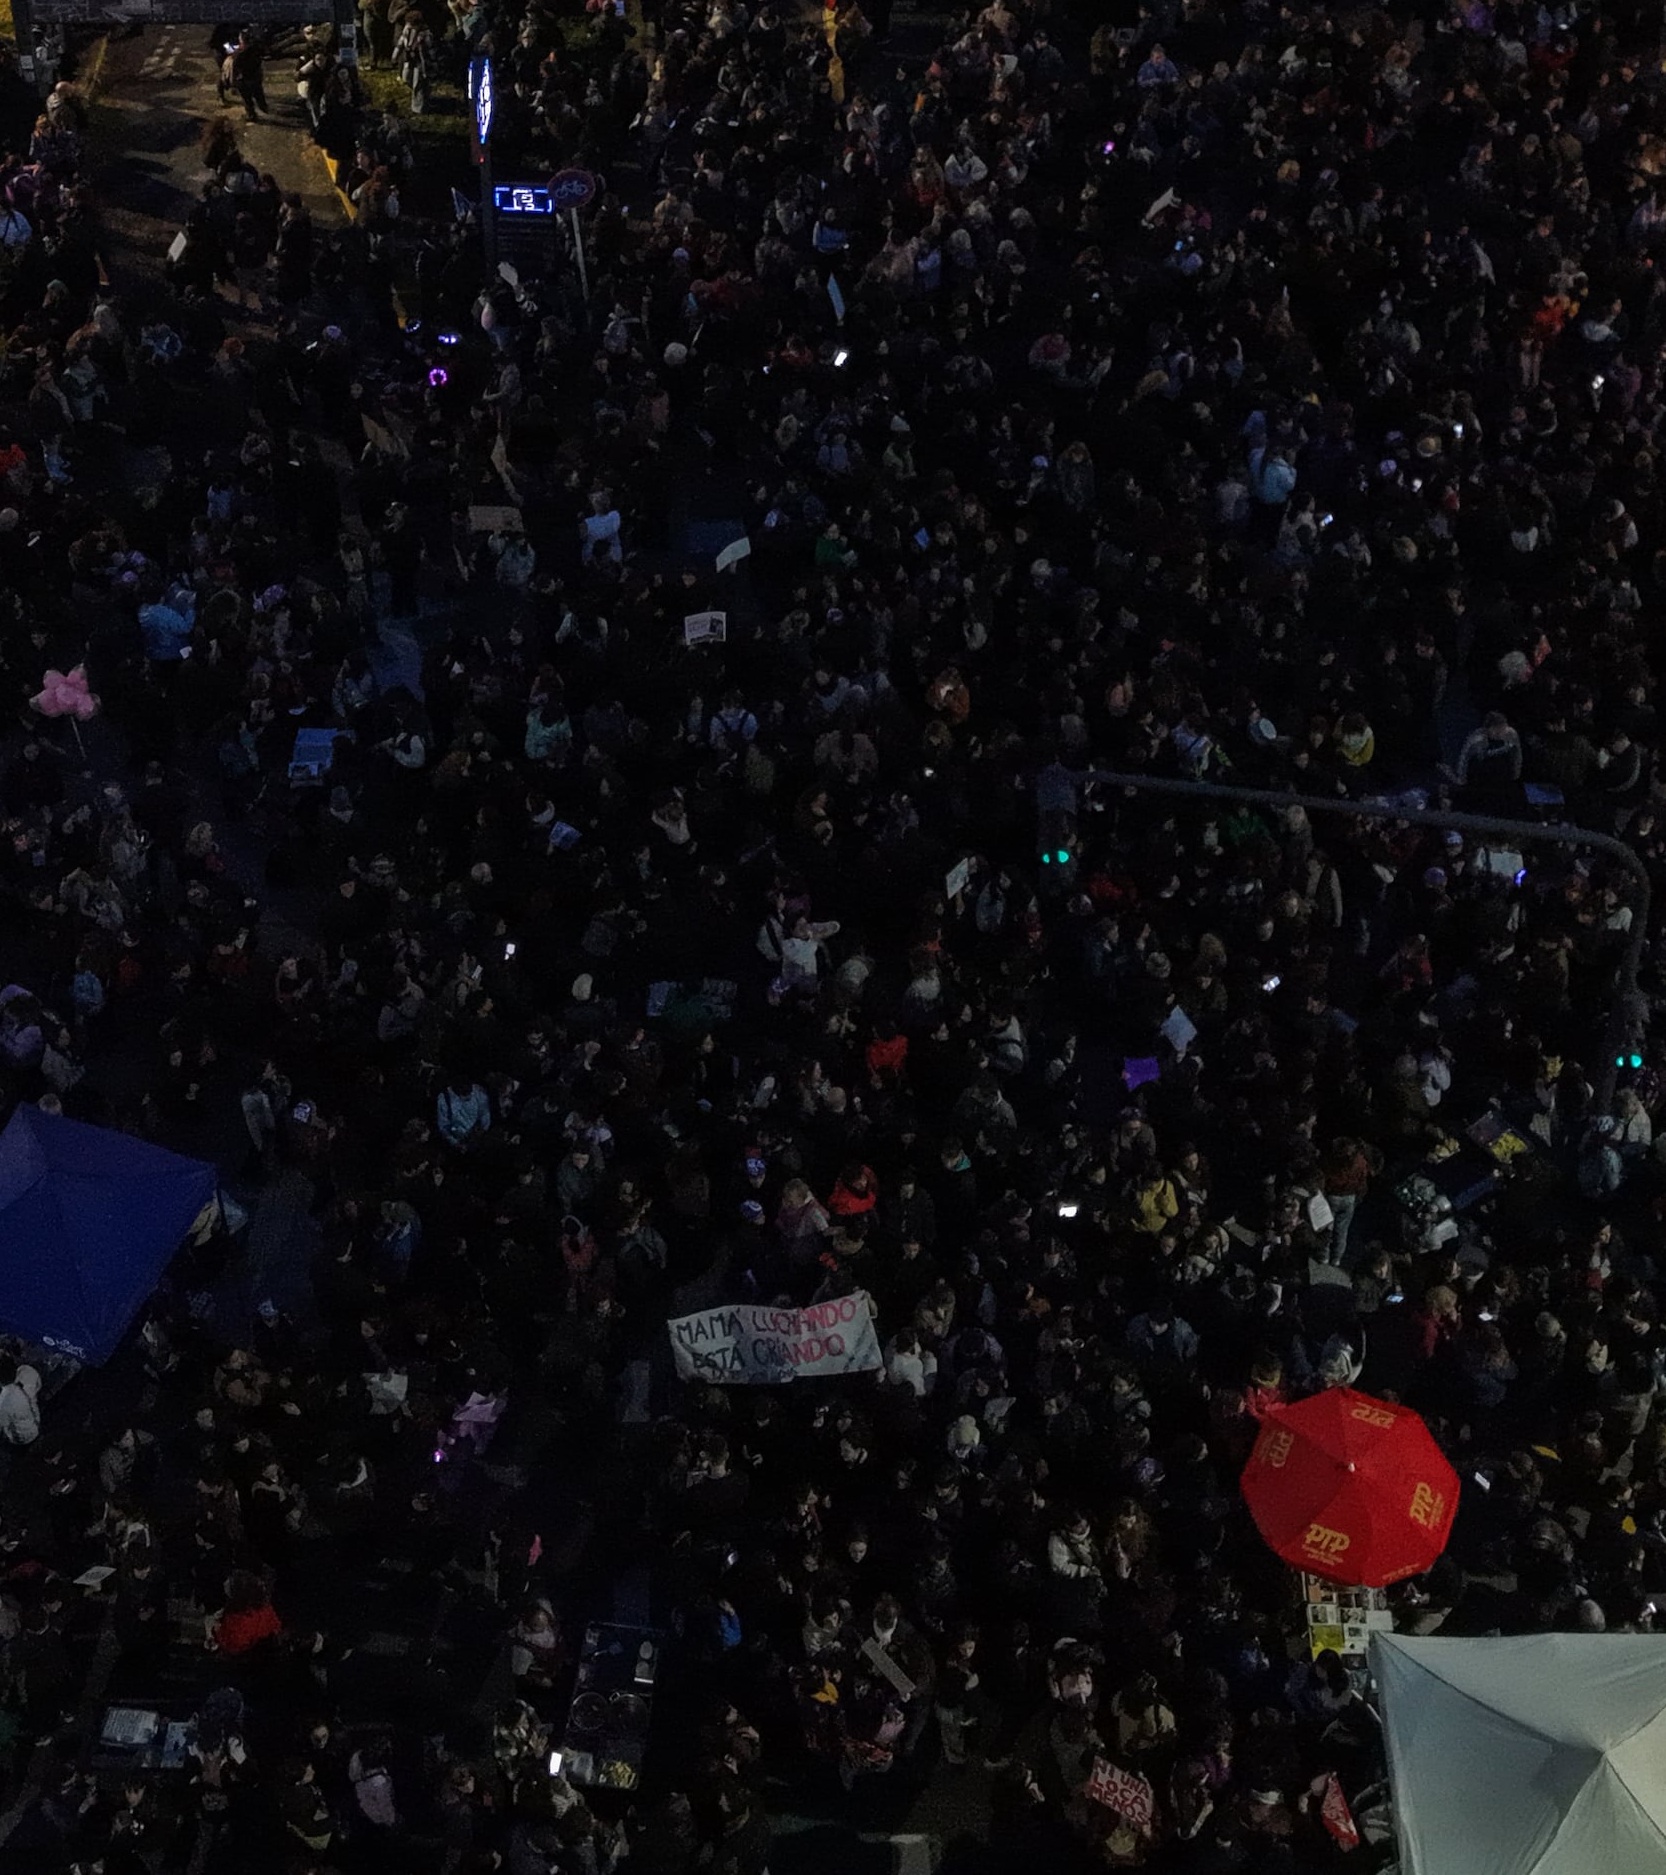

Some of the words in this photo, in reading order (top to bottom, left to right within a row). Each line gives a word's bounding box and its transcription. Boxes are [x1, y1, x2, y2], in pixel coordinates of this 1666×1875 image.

[677, 1307, 745, 1344] MAMÁ
[752, 1298, 857, 1336] LUCHANDO
[691, 1339, 747, 1370] ESTÁ
[1091, 1784, 1149, 1825] MENOS
[1092, 1771, 1148, 1813] LOCA
[1120, 1773, 1150, 1800] UNA
